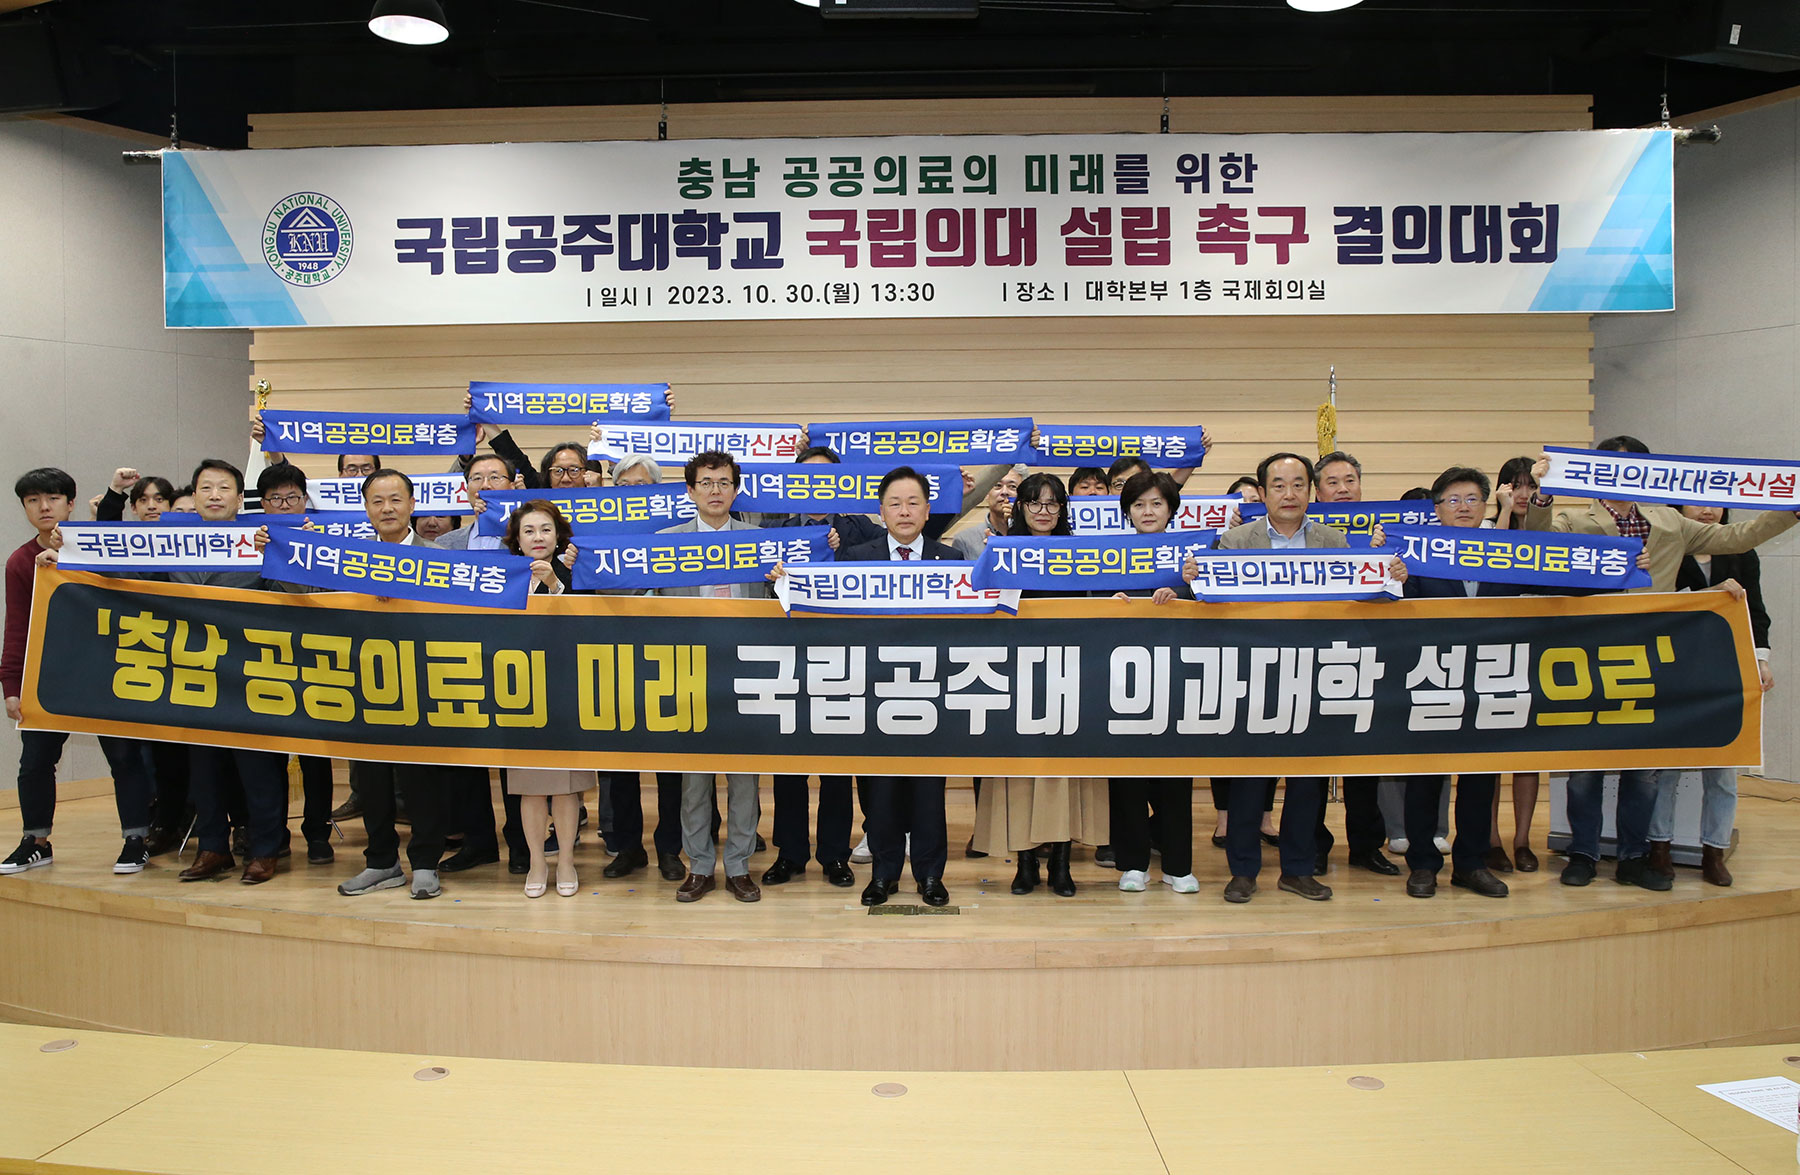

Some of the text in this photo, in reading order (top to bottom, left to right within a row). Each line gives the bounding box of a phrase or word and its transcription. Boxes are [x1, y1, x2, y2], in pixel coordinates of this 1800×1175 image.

[677, 151, 1258, 199] 충남 공공의료의 미래를 위한
[264, 194, 351, 270] KONGJU NATIONAL UNIVERSITY
[394, 201, 1560, 275] 국립공주대학교 국립의대 설립 촉구 결의대회
[284, 268, 331, 285] 공주대학교
[298, 262, 319, 271] 1948
[667, 285, 732, 306] 2023.
[743, 284, 776, 304] 10.
[871, 282, 935, 303] 13:30
[1085, 280, 1169, 302] 대학본부
[1179, 279, 1212, 301] 1층
[1222, 279, 1326, 301] 국제회의실
[484, 391, 652, 415] 지역공공의료확충
[278, 420, 458, 446] 지역공공의료확충
[606, 430, 797, 457] 국립의과대학신설
[825, 428, 1020, 456] 지역공공의료확충
[1037, 434, 1187, 458] 역공공의료확충
[1564, 459, 1797, 500] 국립의과대학신설
[499, 493, 699, 524] 지공공의료확충
[77, 533, 259, 558] 국립의과대학신
[594, 539, 812, 575] 지역공공의료확충
[1402, 535, 1628, 576] 지역공공의료확충
[288, 540, 507, 594] 지역공공의료확충
[1194, 560, 1392, 587] 국립의과대학신
[243, 628, 547, 728] 공공의료의
[577, 643, 708, 732] 미래
[733, 645, 1080, 737] 국립공주대
[1108, 639, 1385, 736] 의과대학
